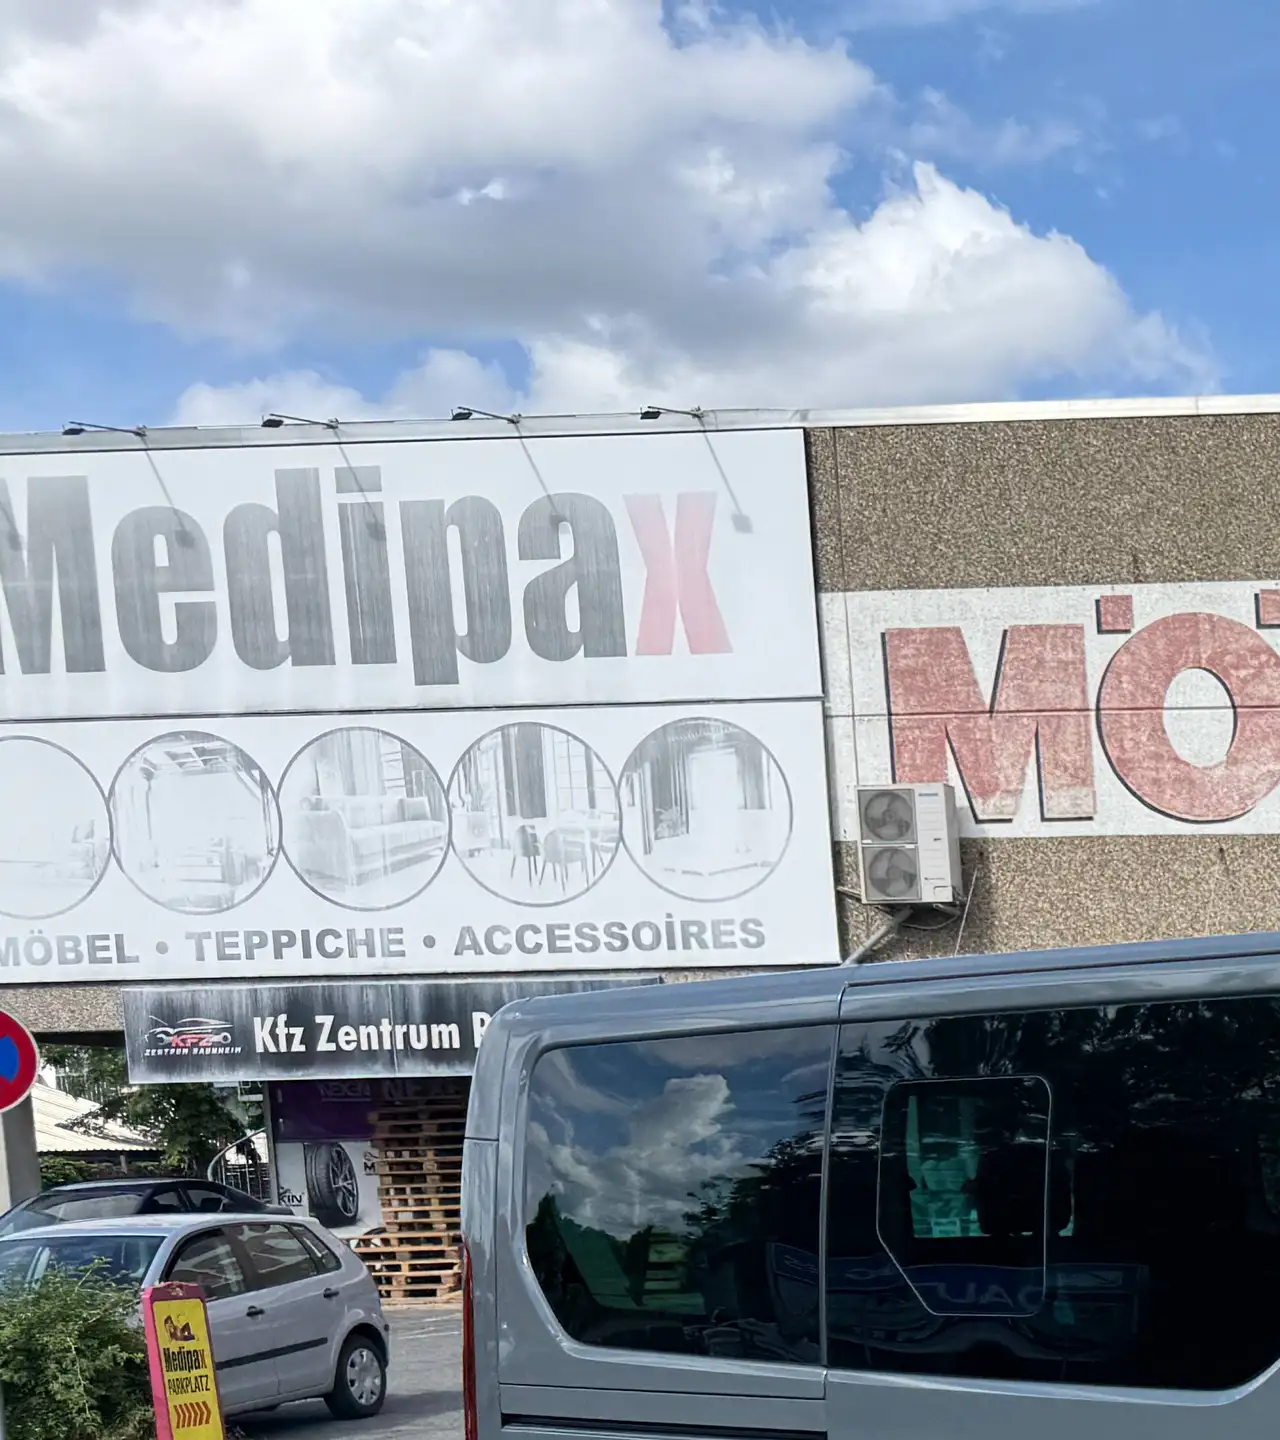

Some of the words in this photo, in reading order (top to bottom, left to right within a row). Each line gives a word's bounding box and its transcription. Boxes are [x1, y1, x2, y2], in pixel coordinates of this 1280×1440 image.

[0, 466, 734, 686] Medipax
[185, 926, 406, 962] TEPPICHE
[254, 1014, 306, 1053] Kfz
[315, 1015, 460, 1052] Zentrum
[163, 1346, 207, 1373] Medipax
[168, 1375, 210, 1396] PARKPLATZ
